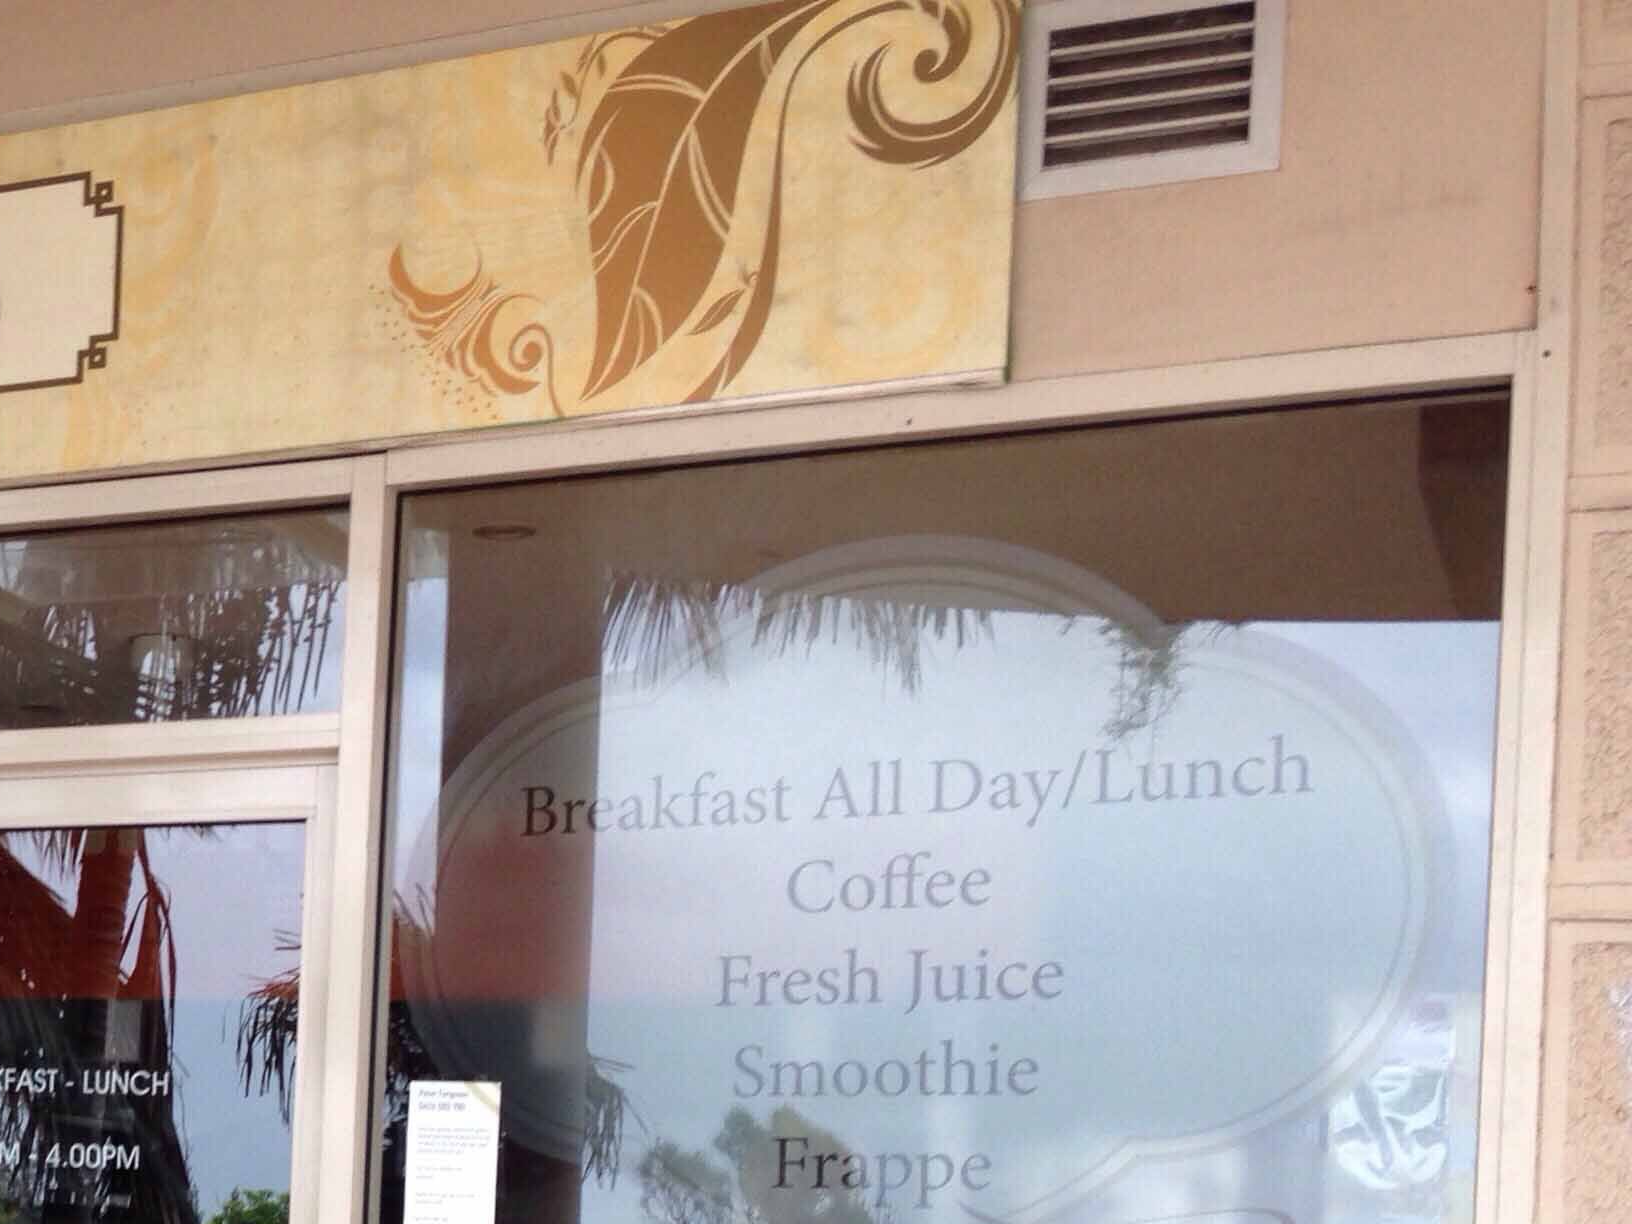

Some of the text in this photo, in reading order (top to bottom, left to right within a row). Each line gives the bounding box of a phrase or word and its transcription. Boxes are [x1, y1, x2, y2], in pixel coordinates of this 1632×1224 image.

[520, 735, 1314, 838] Breakfast All Day/Lunch
[786, 850, 993, 914] Coffee
[714, 947, 1066, 1016] Fresh Juice
[82, 1069, 170, 1097] LUNCH
[733, 1040, 1041, 1098] Smoothie
[45, 1144, 141, 1171] 4.00PM
[771, 1136, 994, 1210] Frappe
